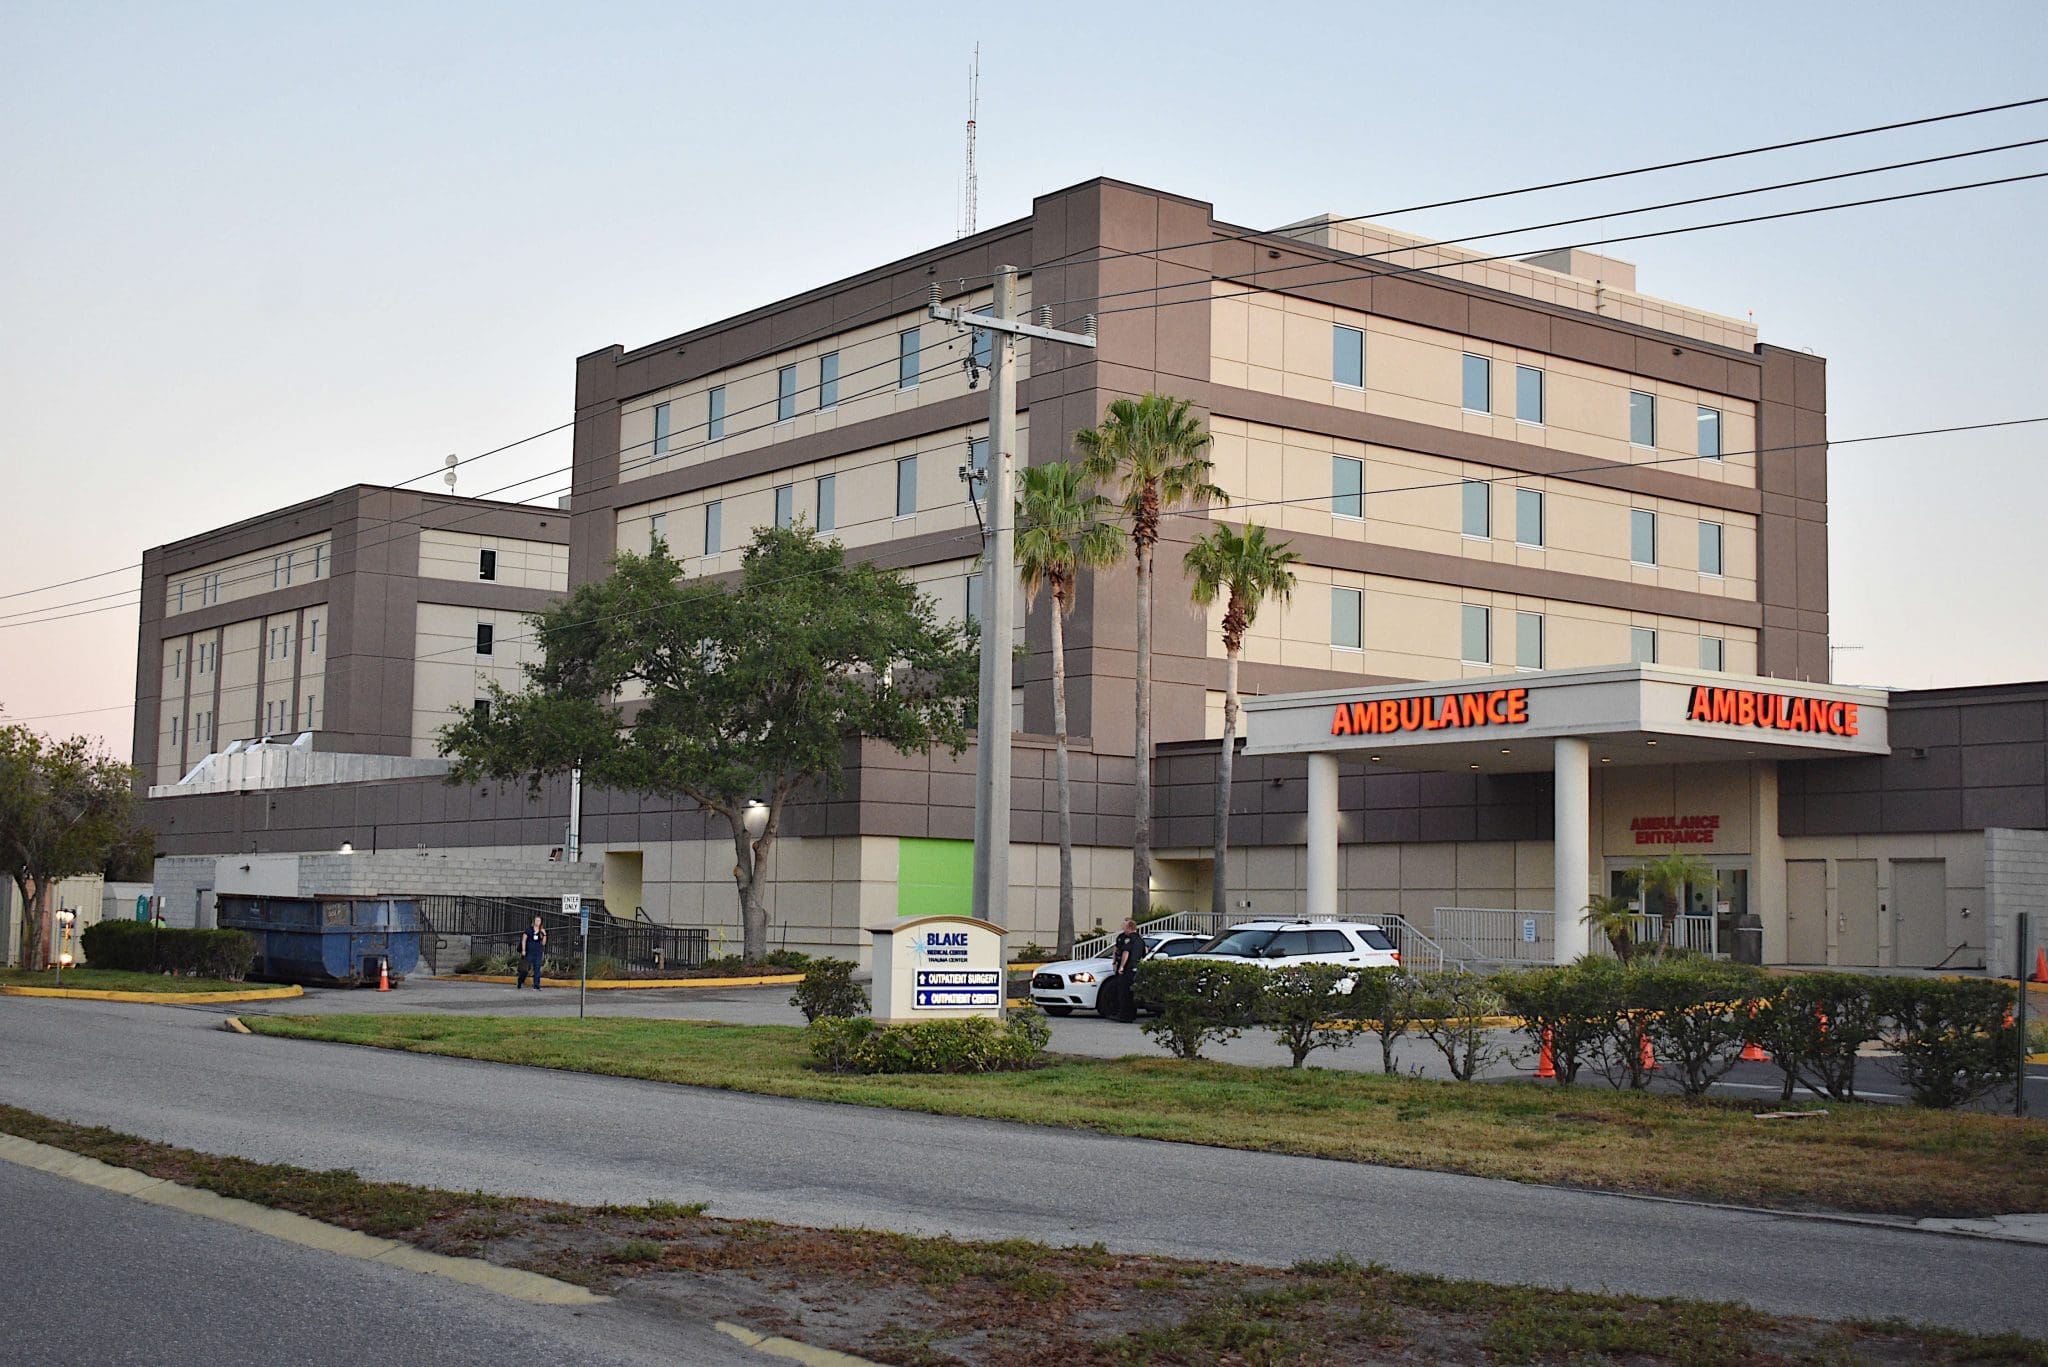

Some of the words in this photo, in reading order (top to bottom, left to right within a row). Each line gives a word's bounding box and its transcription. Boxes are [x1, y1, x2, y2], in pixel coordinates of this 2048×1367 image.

[1331, 688, 1528, 735] AMBULANCE
[1687, 686, 1858, 736] AMBULANCE
[1630, 815, 1719, 830] AMBULANCE
[1635, 830, 1713, 844] ENTRANCE
[927, 933, 968, 946] BLAKE
[928, 973, 967, 984] OUTPATIENT
[968, 973, 998, 984] SURGERY
[931, 993, 971, 1004] OUTPATIENT
[971, 993, 997, 1004] CENTER
